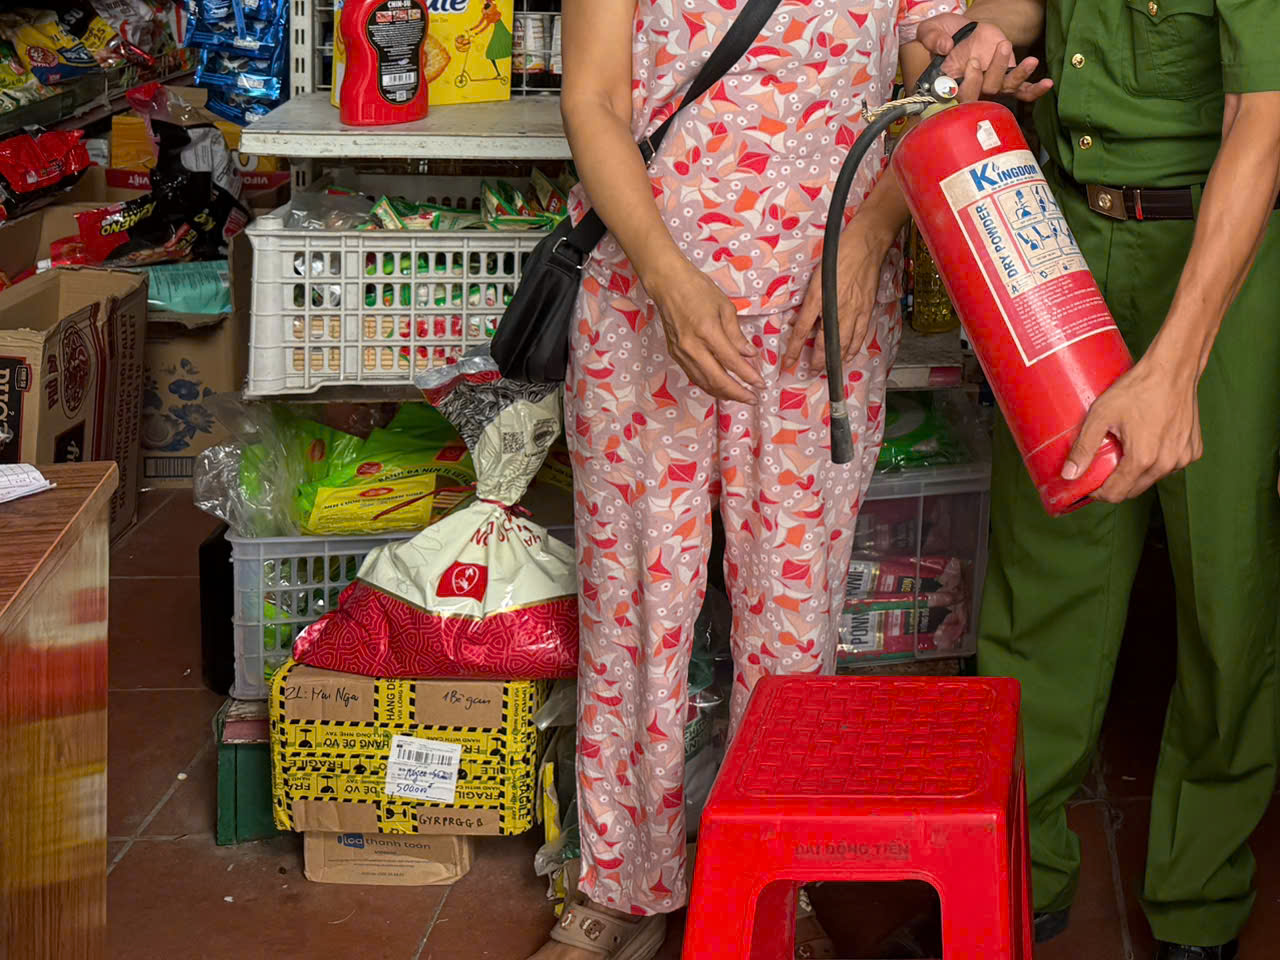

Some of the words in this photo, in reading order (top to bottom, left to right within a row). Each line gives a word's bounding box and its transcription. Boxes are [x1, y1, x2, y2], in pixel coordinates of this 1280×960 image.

[978, 202, 1007, 254] POWDER
[999, 254, 1019, 279] DRY
[385, 692, 396, 721] HÀNG
[358, 738, 390, 750] HÀNG
[289, 758, 344, 770] FRAGILE
[456, 791, 500, 800] FRAGIL
[365, 836, 401, 850] thanh
